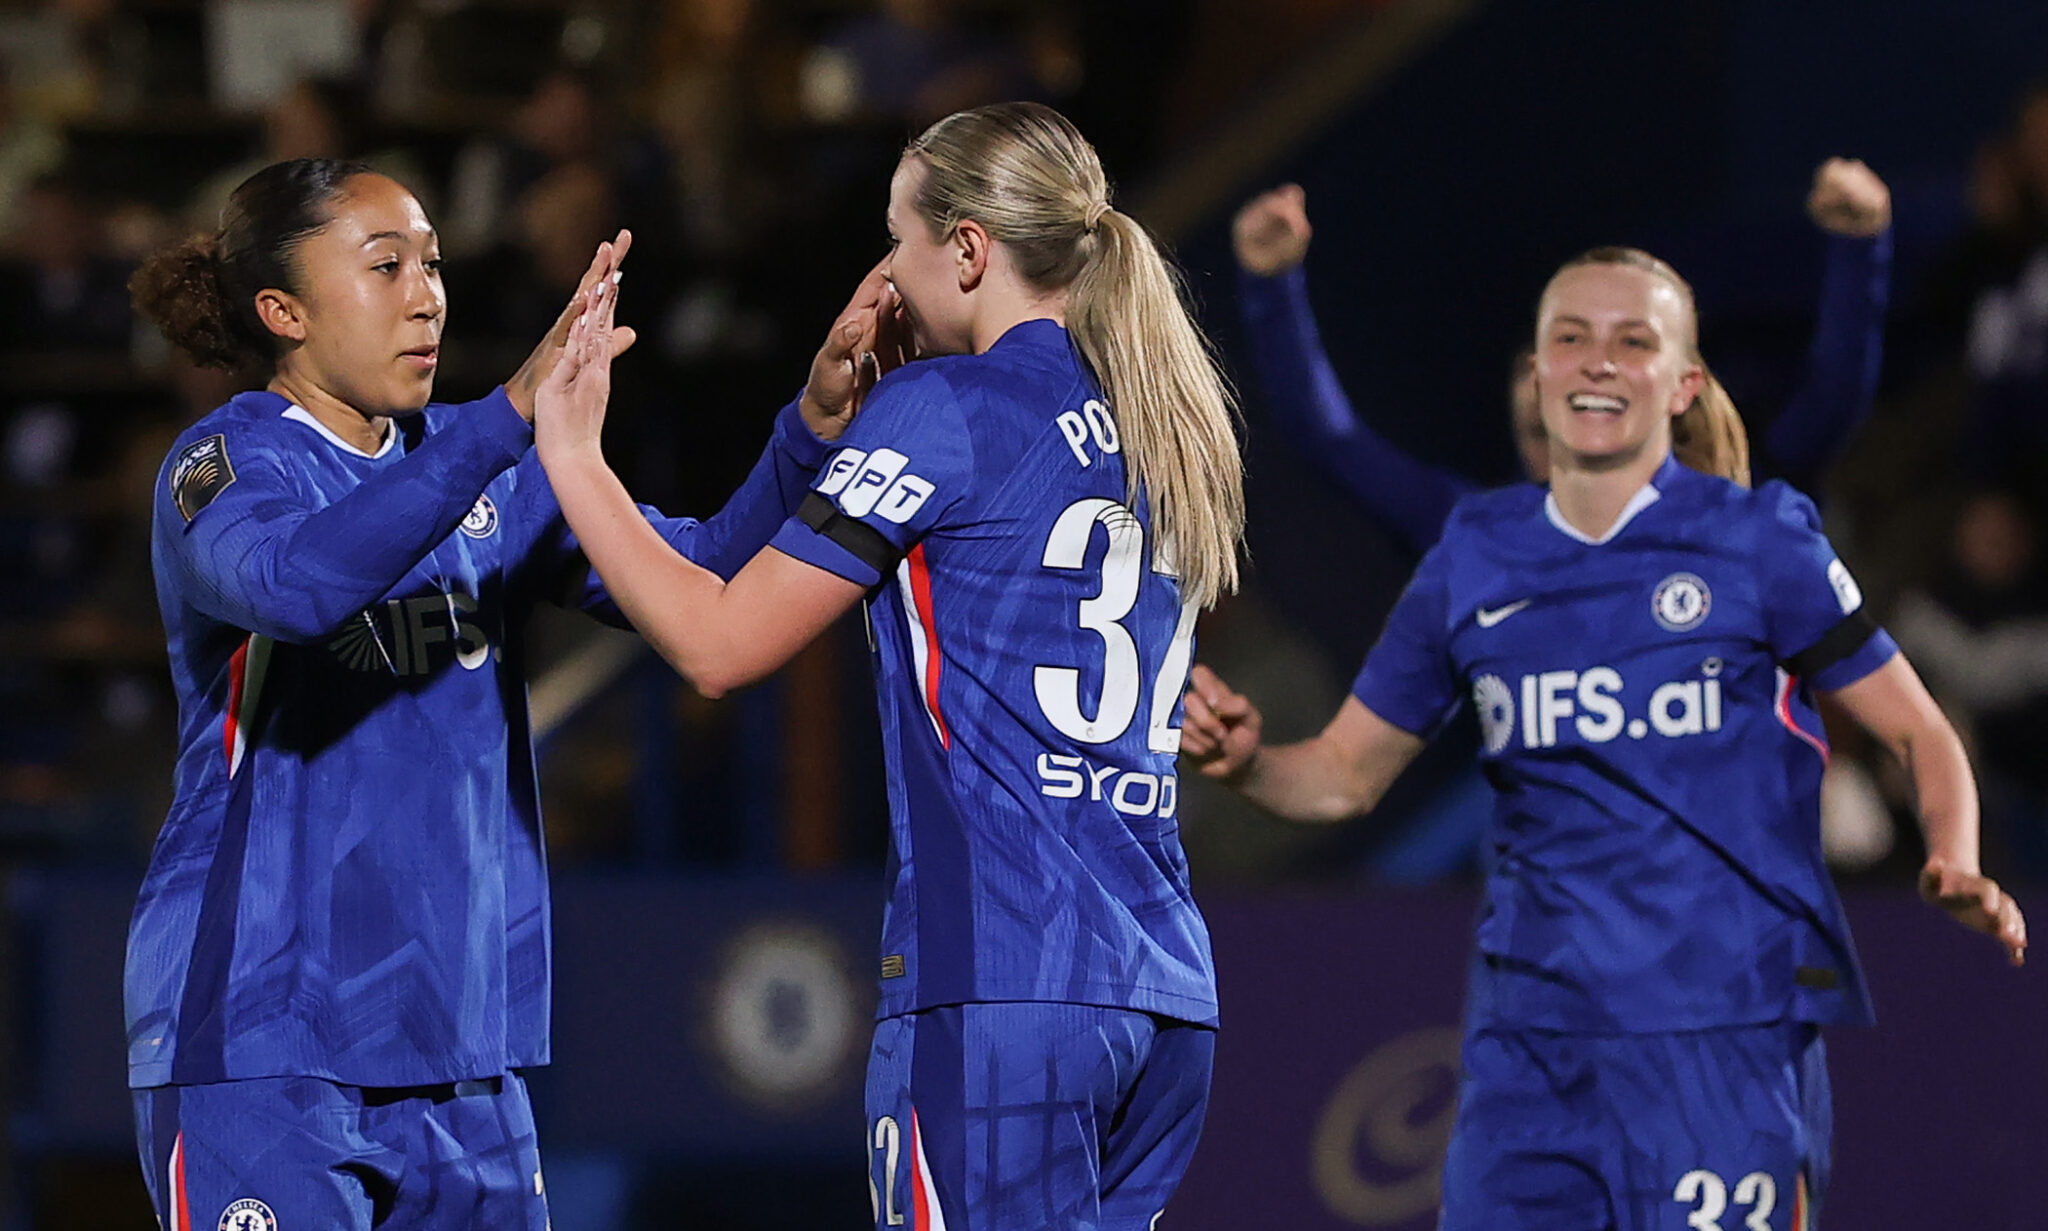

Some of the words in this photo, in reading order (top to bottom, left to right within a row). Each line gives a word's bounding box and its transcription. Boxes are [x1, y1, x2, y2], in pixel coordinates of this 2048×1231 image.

[1056, 399, 1120, 468] PO
[826, 456, 925, 511] FPT
[1033, 497, 1202, 754] 32
[1520, 656, 1724, 750] IFS.ai
[1673, 1169, 1777, 1231] 33
